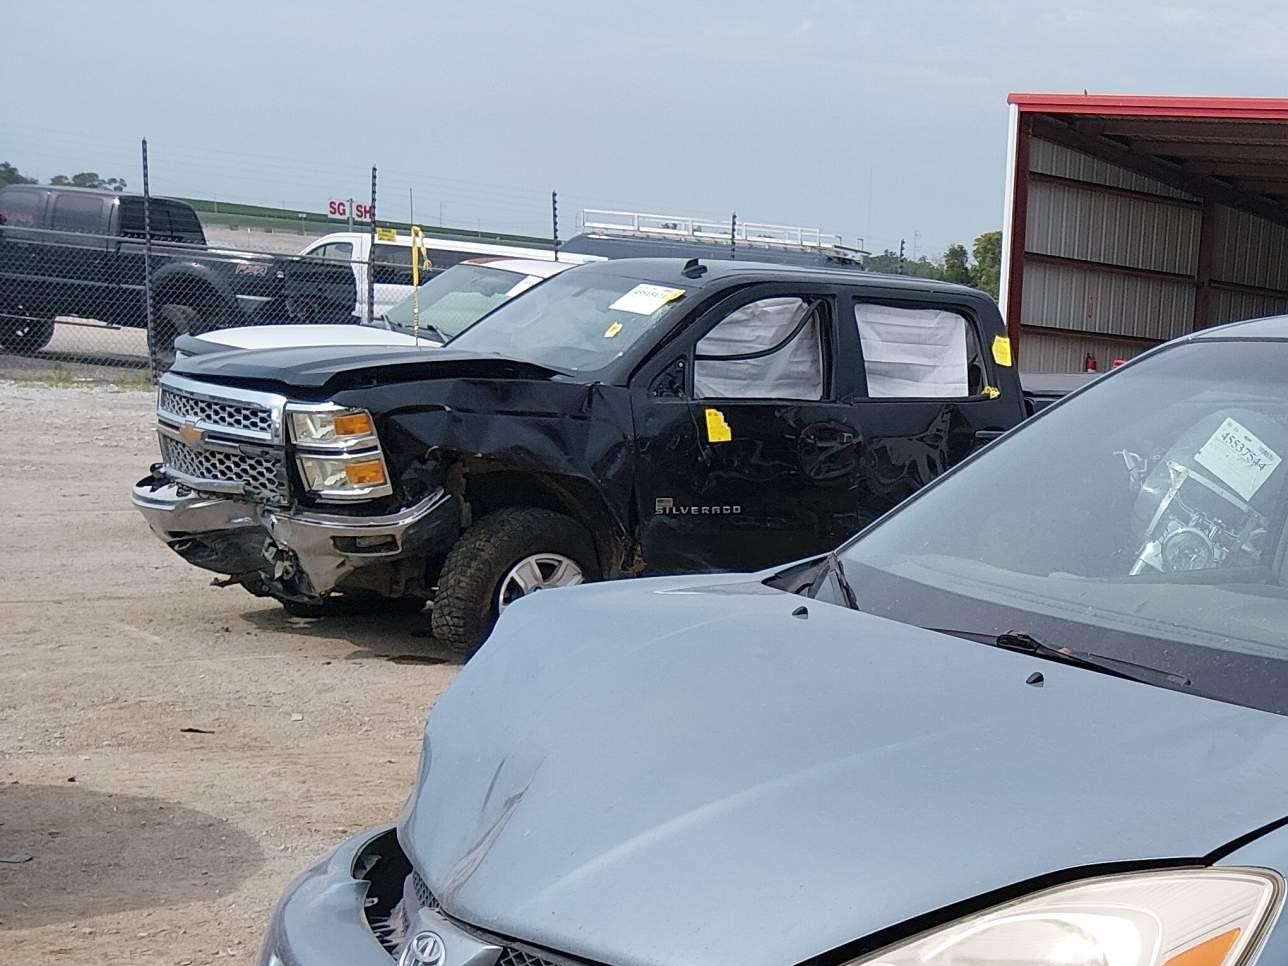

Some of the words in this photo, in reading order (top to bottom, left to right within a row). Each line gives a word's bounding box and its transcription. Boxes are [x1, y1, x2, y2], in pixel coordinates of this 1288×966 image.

[329, 201, 346, 216] SG
[1221, 432, 1267, 471] 45537544
[655, 506, 741, 515] SILVERADO
